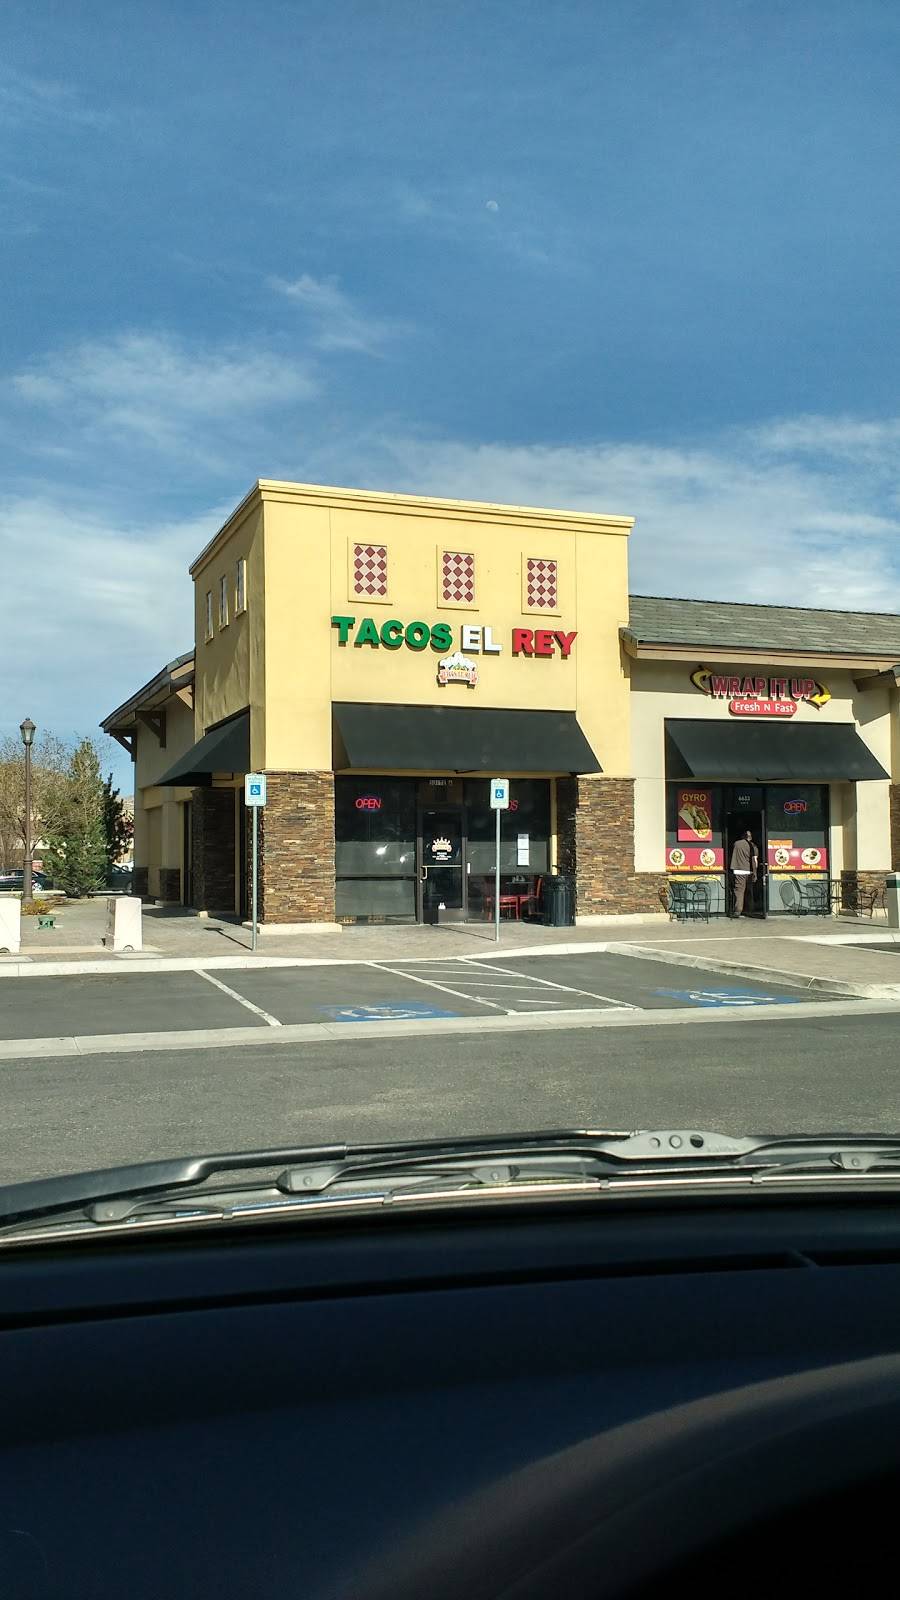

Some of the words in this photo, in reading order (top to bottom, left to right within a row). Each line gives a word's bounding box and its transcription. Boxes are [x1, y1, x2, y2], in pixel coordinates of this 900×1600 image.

[331, 616, 453, 652] TACOS
[461, 624, 503, 653] EL
[511, 628, 578, 658] REY
[710, 675, 766, 698] WRAP
[769, 677, 787, 699] IT
[791, 678, 816, 699] UP
[734, 701, 761, 712] Fresh
[763, 703, 771, 712] N
[774, 702, 794, 713] Fast
[355, 797, 382, 809] OPEN
[681, 793, 708, 802] GYRO
[783, 801, 807, 813] OPEN
